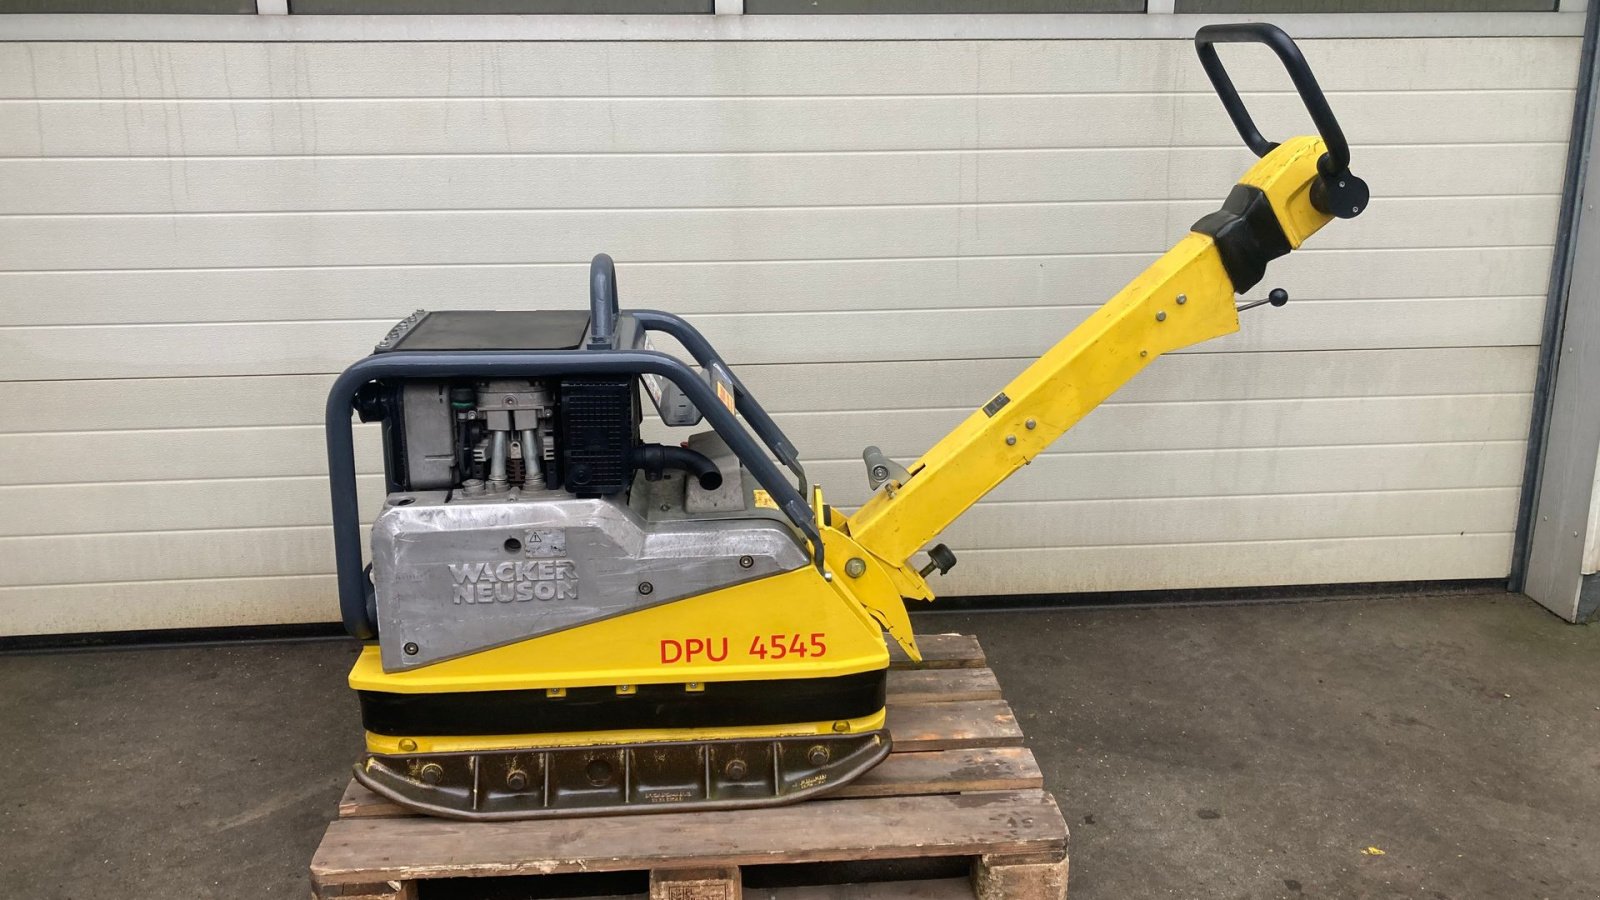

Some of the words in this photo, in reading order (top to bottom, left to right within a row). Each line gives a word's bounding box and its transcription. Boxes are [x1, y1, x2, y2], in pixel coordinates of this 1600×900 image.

[448, 560, 579, 584] WACKER
[452, 580, 578, 604] NEUSON
[660, 637, 728, 664] DPU
[749, 633, 826, 659] 4545
